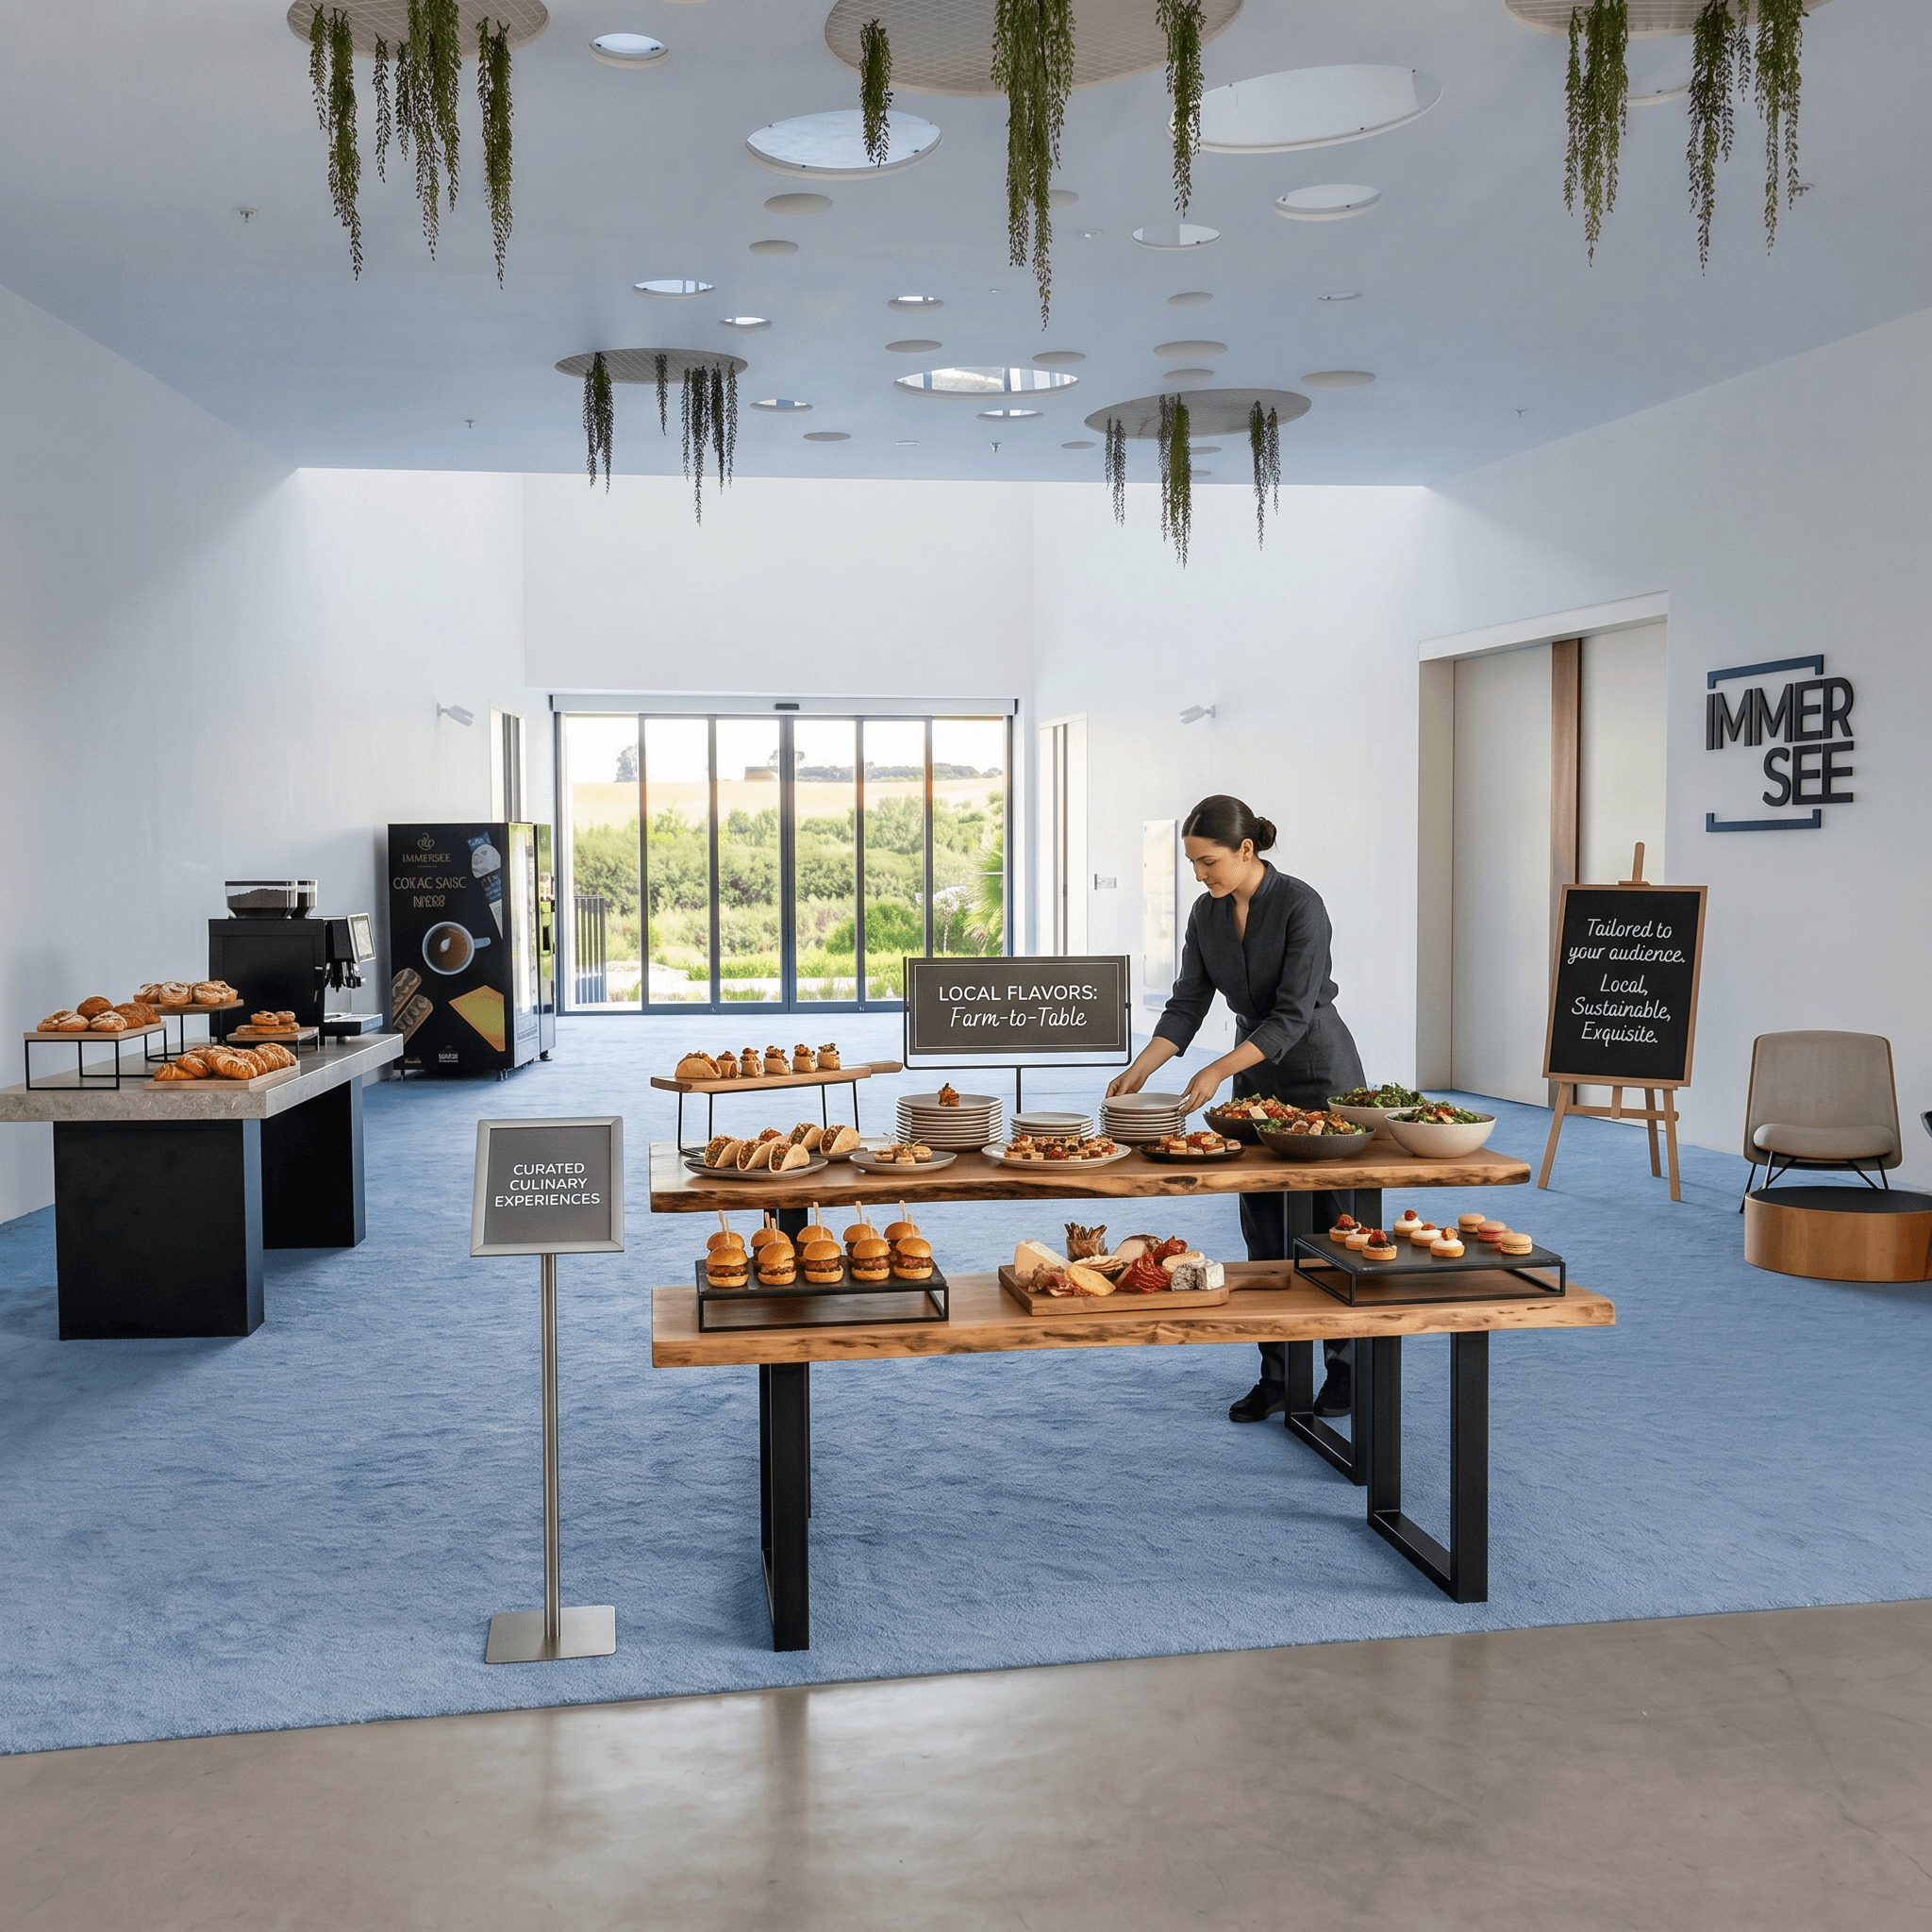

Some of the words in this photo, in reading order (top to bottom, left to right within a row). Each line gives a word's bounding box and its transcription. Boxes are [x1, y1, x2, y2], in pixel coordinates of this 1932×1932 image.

[1706, 676, 1855, 751] IMMER
[1762, 741, 1855, 808] SEE
[1587, 918, 1654, 938] Tailored
[1656, 922, 1673, 939] to
[1567, 946, 1606, 965] your
[1608, 943, 1686, 963] audience.
[939, 986, 1001, 1002] LOCAL
[1007, 984, 1098, 1001] FLAVORS:
[1600, 974, 1649, 996] Local,
[950, 1005, 1088, 1027] Farm-to-Table
[1571, 996, 1672, 1022] Sustainable,
[1581, 1021, 1658, 1047] Exquisite.
[513, 1162, 585, 1175] CURATED
[509, 1177, 589, 1191] CULINARY
[494, 1192, 601, 1208] EXPERIENCES
